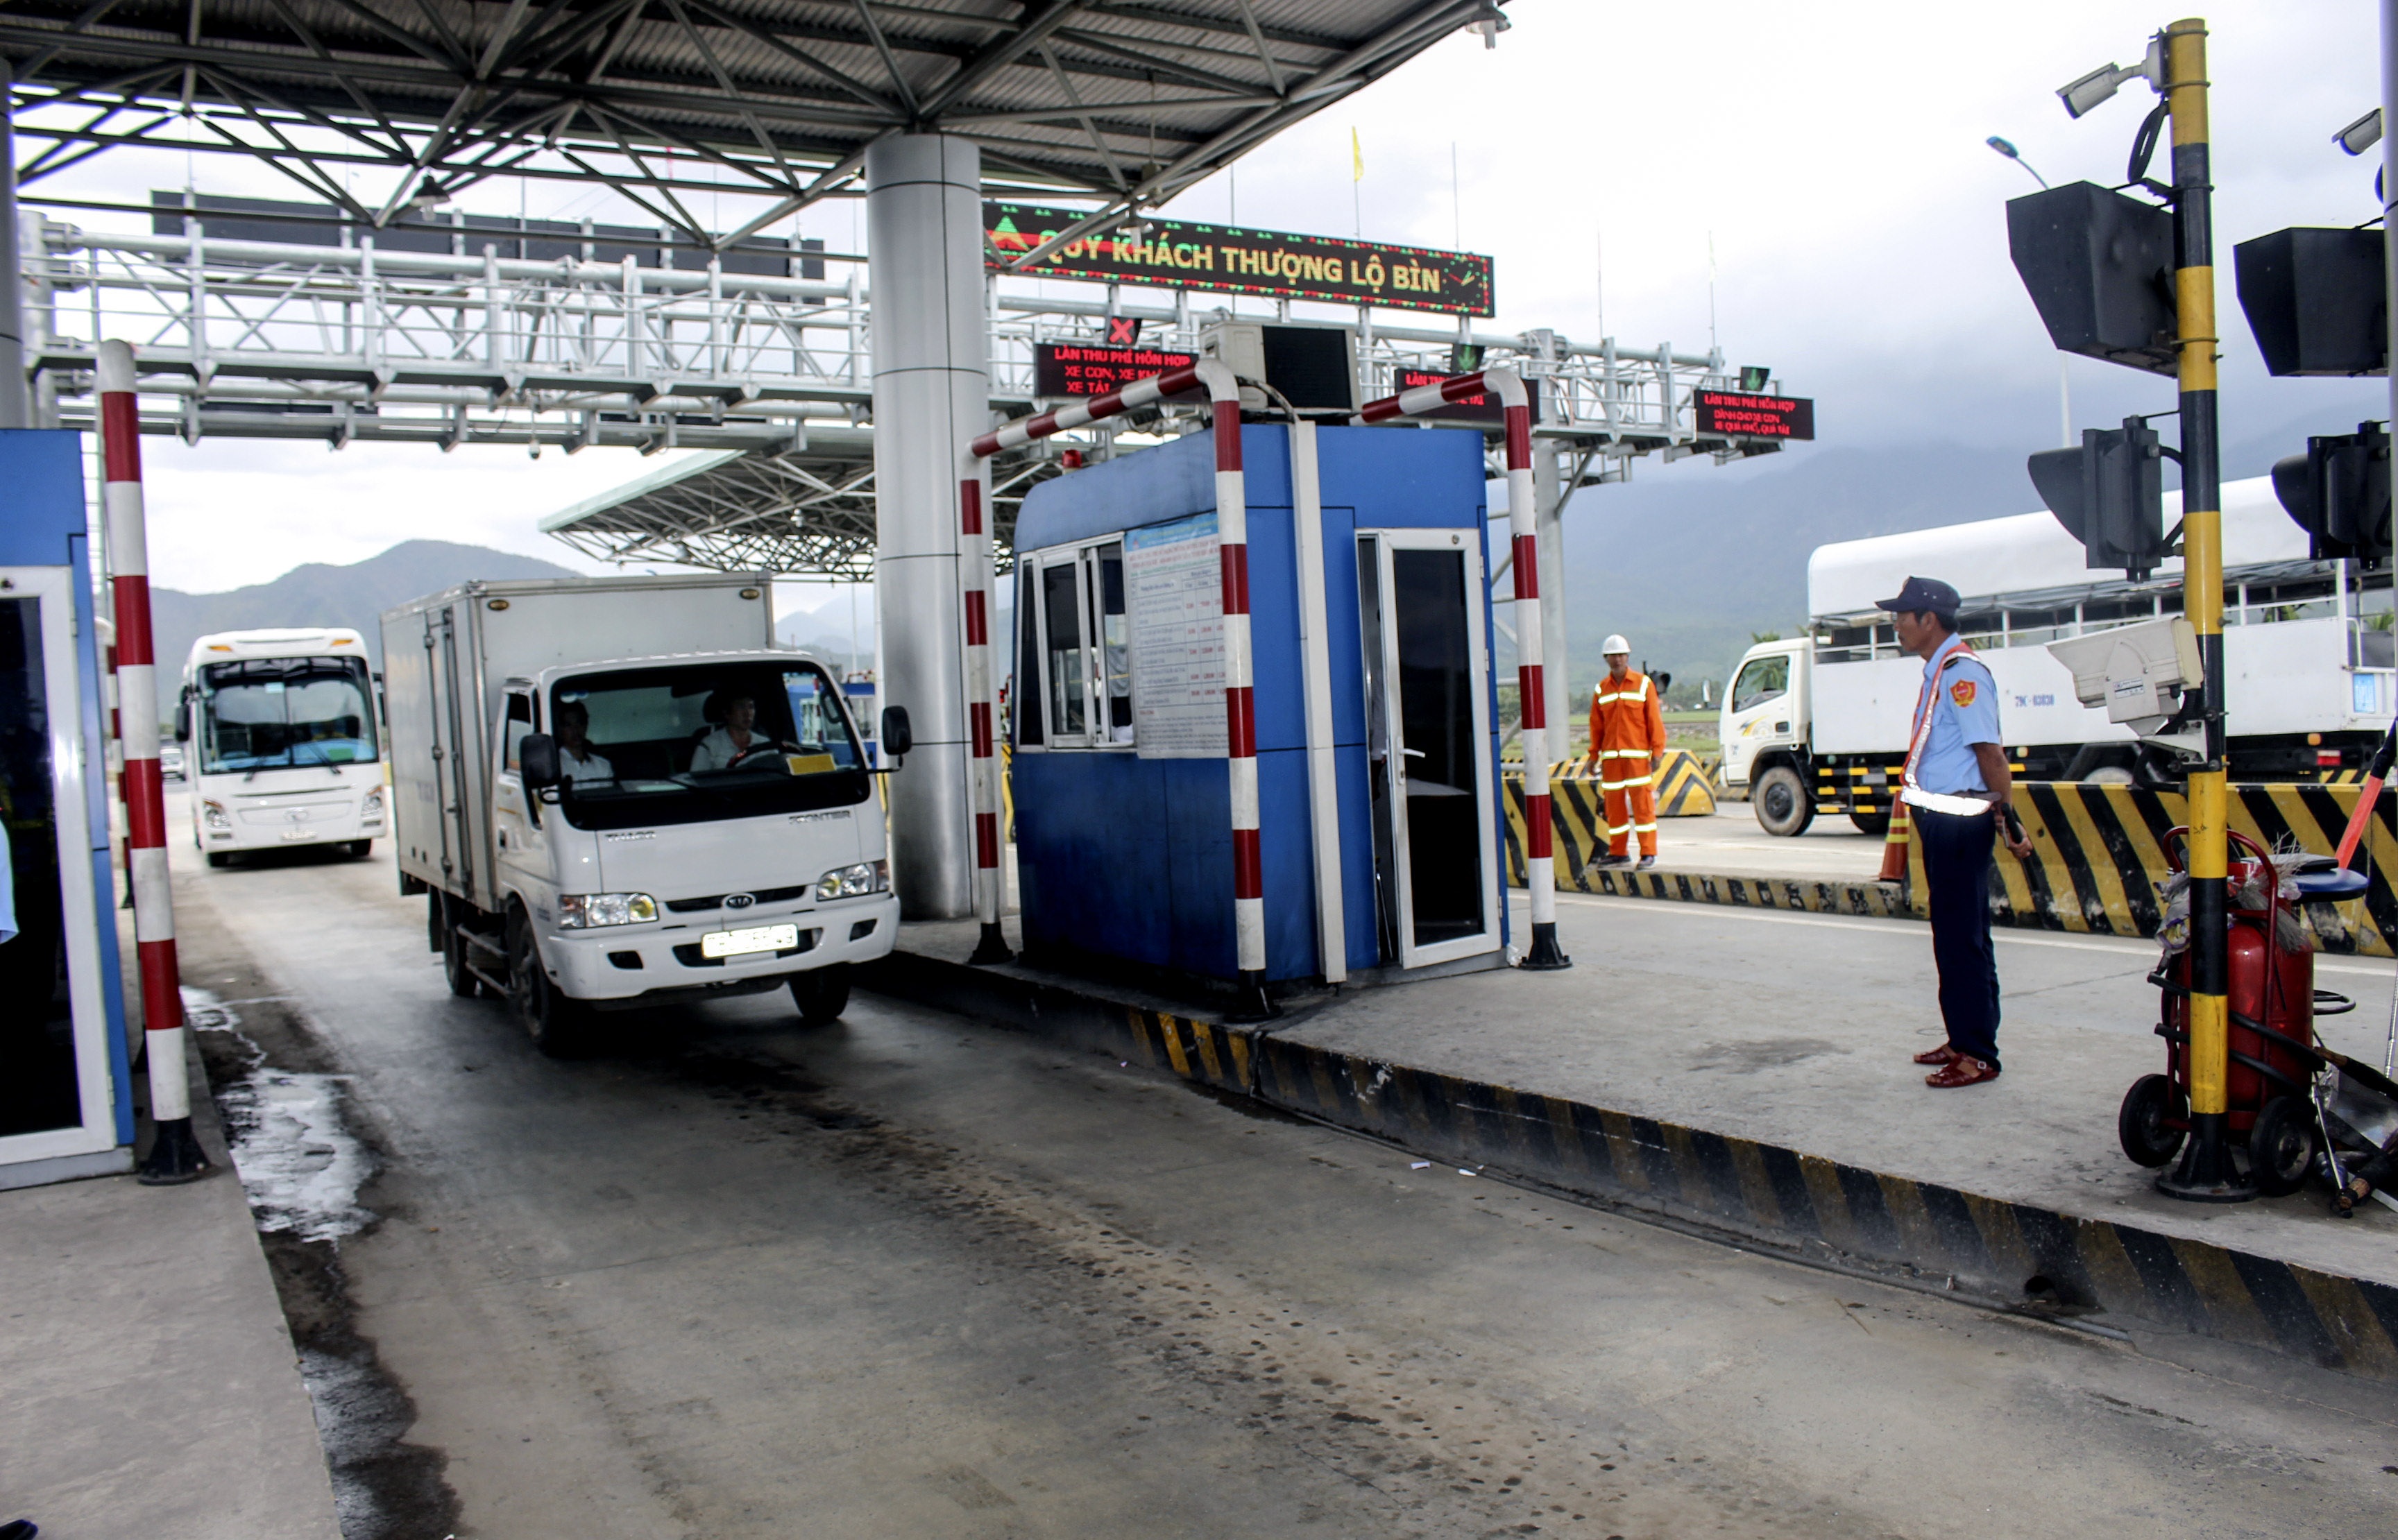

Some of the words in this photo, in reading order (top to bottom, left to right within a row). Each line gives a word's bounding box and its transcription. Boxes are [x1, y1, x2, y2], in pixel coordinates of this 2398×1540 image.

[1112, 232, 1213, 271] KHÁCH
[1220, 246, 1343, 285] THƯỢNG
[1350, 254, 1385, 294] LỘ
[1392, 258, 1440, 293] BÌN
[1082, 349, 1108, 362] THU
[1111, 349, 1132, 364] PHÍ
[1065, 365, 1082, 378] XE
[1119, 368, 1136, 380] XE
[1066, 381, 1083, 393] XE
